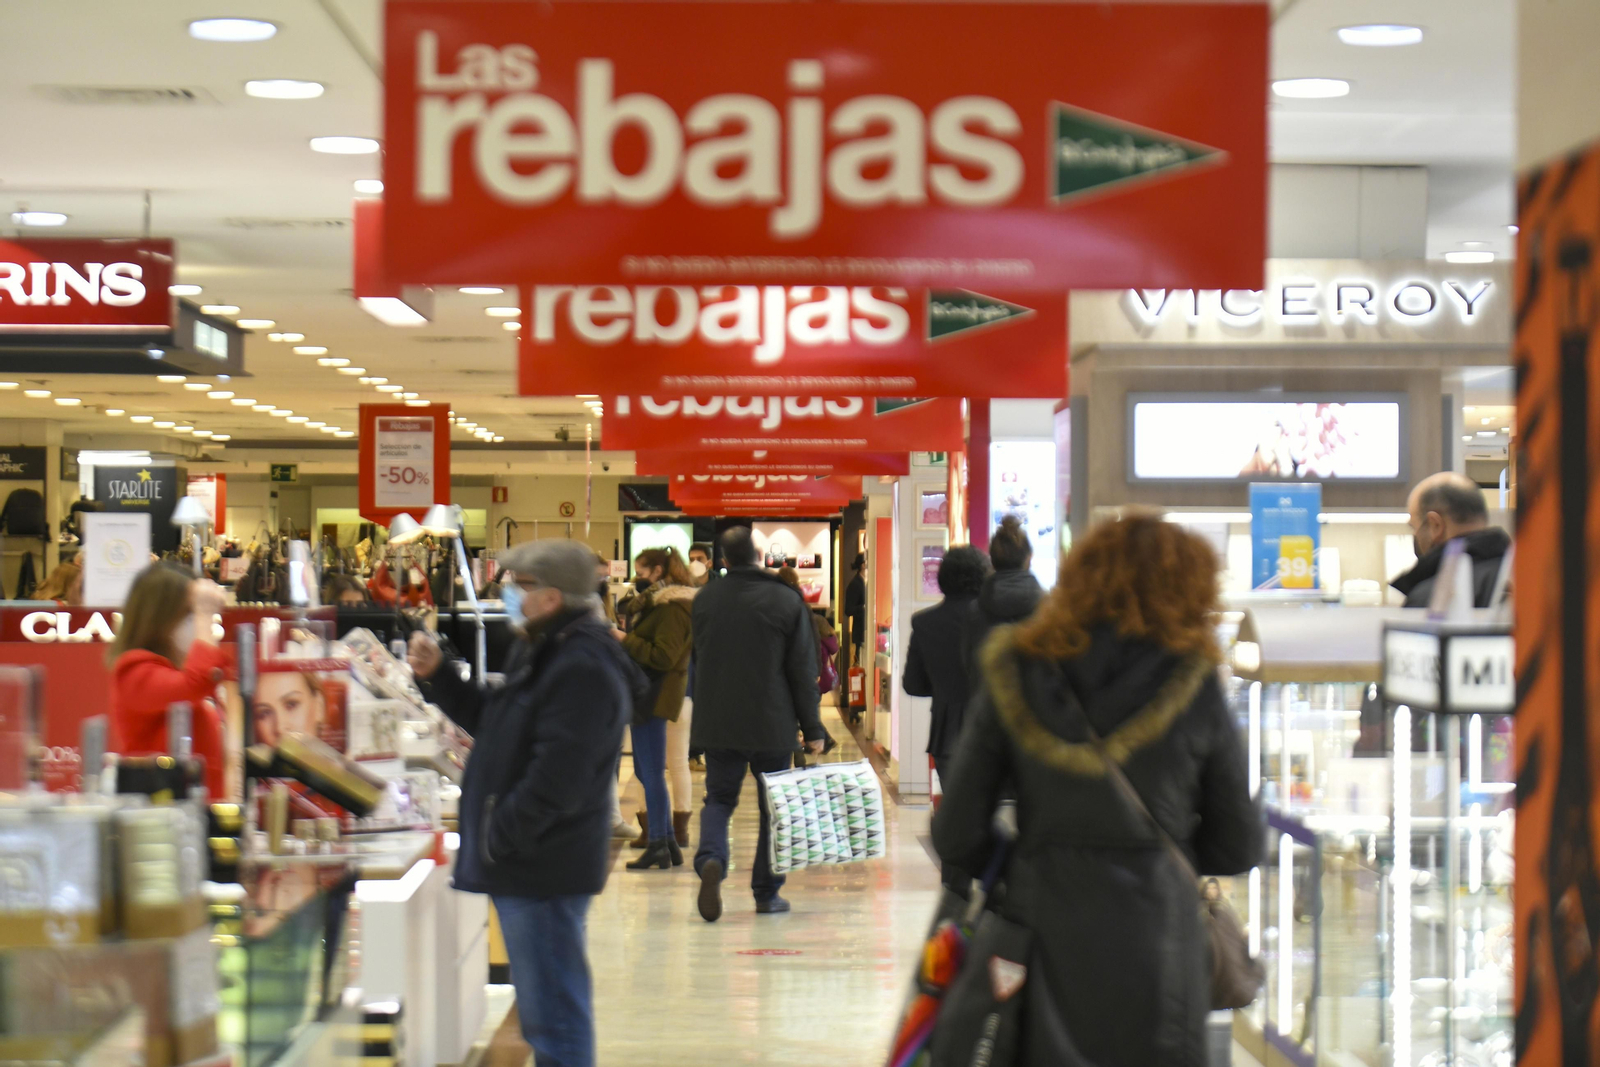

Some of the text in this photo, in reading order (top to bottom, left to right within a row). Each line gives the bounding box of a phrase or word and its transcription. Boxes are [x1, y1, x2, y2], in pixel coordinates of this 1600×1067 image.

[417, 29, 539, 90] Las
[417, 58, 1024, 237] rebajas
[1130, 280, 1496, 325] VICEROY
[701, 437, 868, 446] SI NO QUEDA SATISFECHO LE DEVOLVEMOS SU DINERO
[109, 480, 163, 499] STARLITE
[380, 466, 430, 485] -50%
